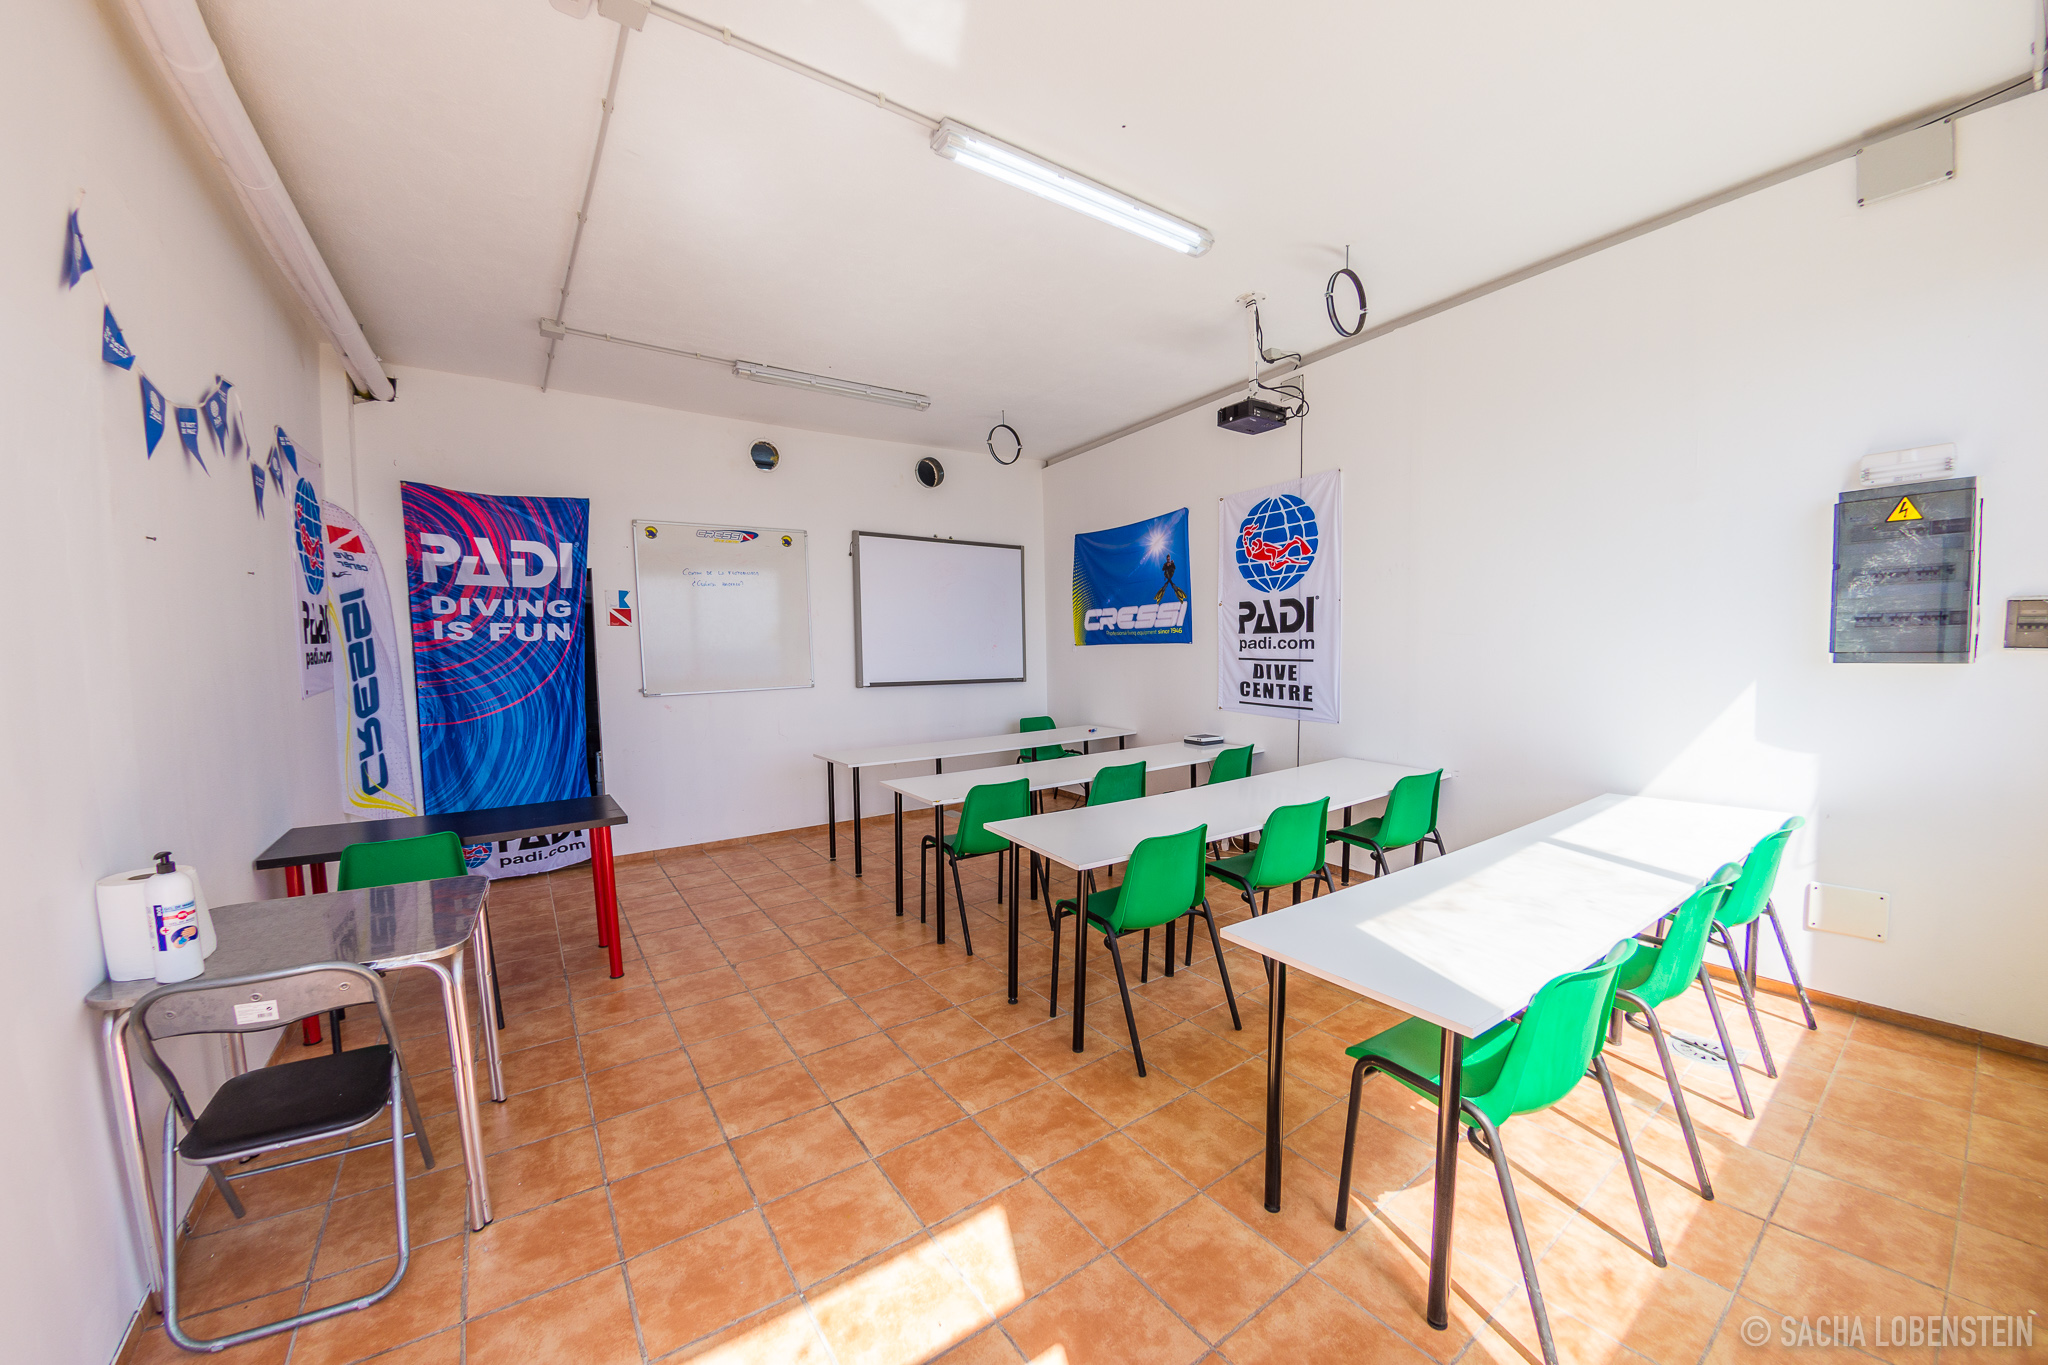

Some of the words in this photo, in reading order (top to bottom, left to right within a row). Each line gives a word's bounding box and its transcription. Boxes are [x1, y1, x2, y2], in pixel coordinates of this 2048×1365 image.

[696, 529, 743, 541] CRESSI
[420, 532, 573, 588] PADI
[431, 596, 571, 617] DIVING
[1084, 601, 1188, 631] CRESSI
[1238, 596, 1315, 634] PADI
[433, 620, 473, 640] IS
[490, 623, 570, 641] FUN
[1239, 637, 1315, 652] padi.com
[1253, 663, 1297, 681] DIVE
[1240, 681, 1313, 702] CENTRE
[500, 840, 586, 868] padi.com
